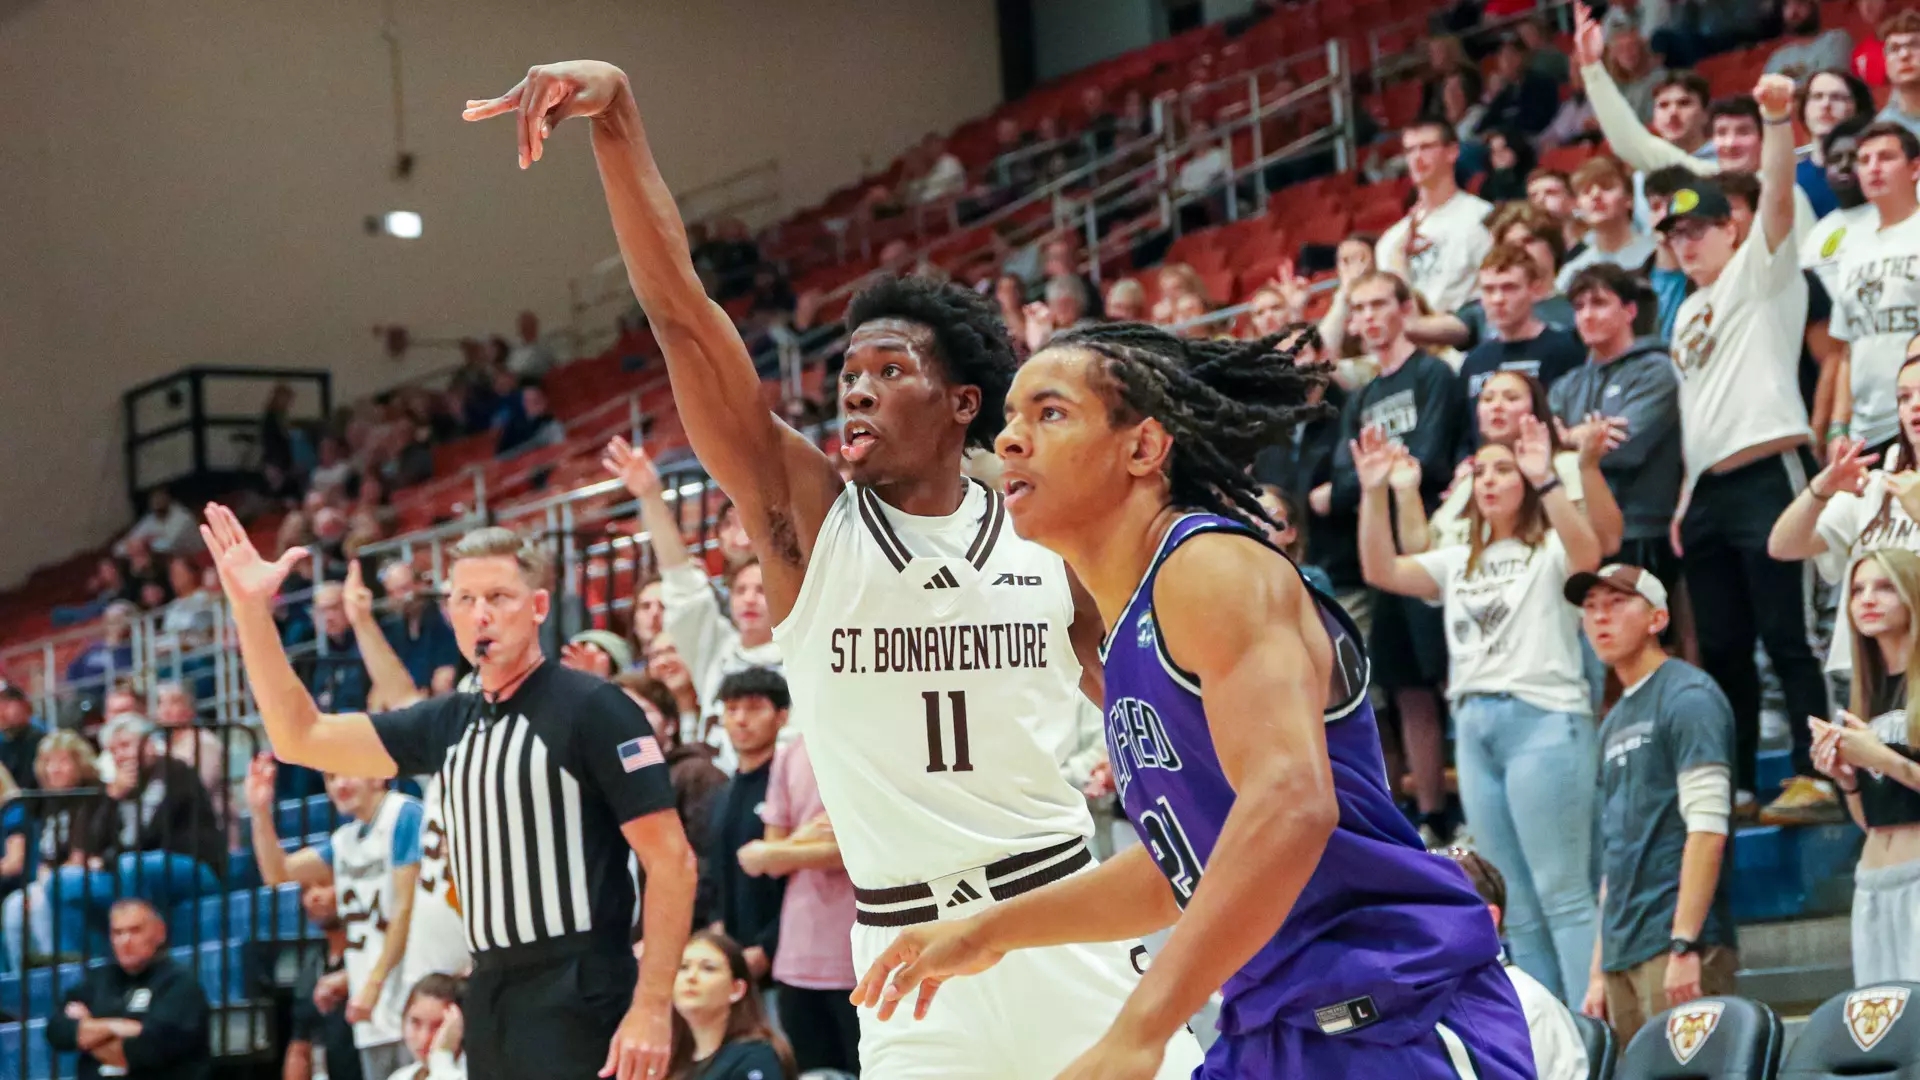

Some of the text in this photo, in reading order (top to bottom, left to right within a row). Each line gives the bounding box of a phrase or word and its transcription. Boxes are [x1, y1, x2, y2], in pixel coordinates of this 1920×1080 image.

[991, 573, 1042, 586] A10
[831, 623, 1049, 673] ST. BONAVENTURE
[921, 690, 974, 773] 11
[1108, 696, 1183, 810] LFRED
[1139, 795, 1204, 914] 21
[1356, 1005, 1369, 1019] L
